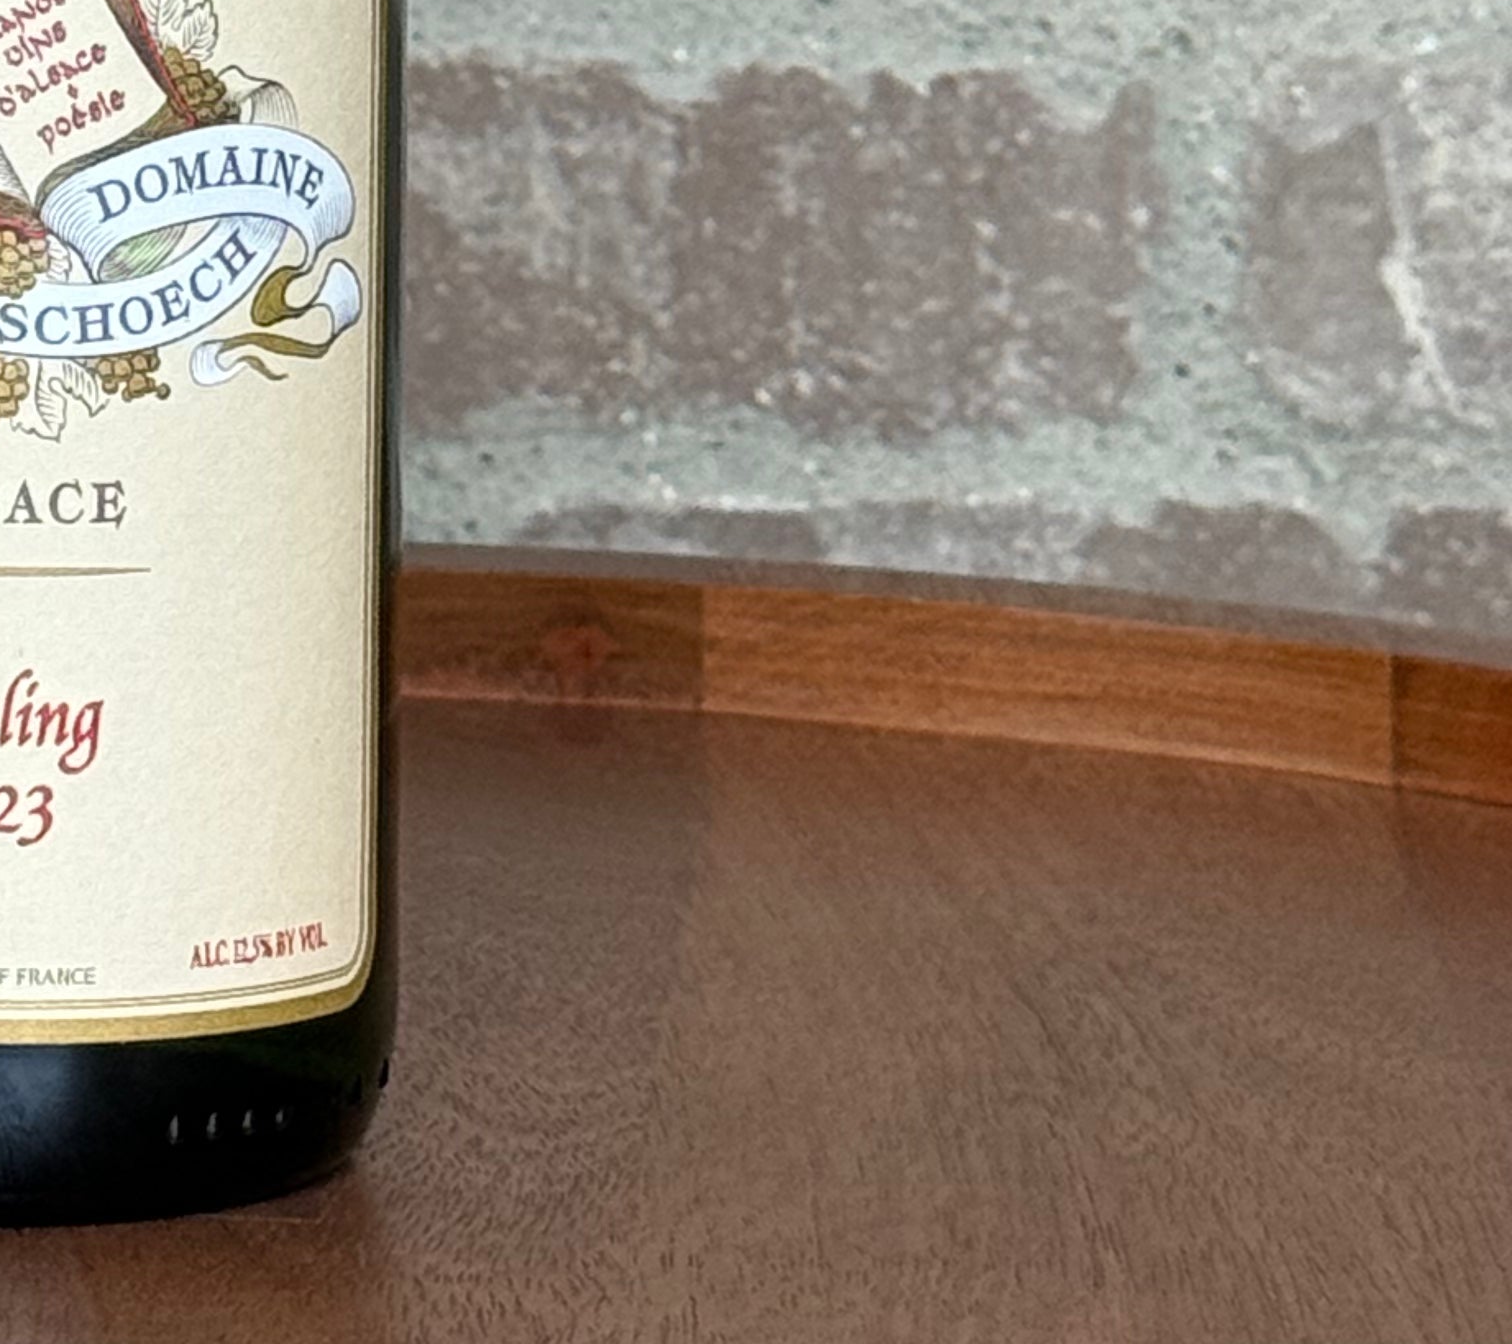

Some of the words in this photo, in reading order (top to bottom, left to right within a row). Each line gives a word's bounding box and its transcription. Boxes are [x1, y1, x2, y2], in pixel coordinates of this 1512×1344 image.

[89, 144, 326, 224] DOMAINE
[275, 927, 296, 958] BY
[16, 967, 97, 987] FRANCE
